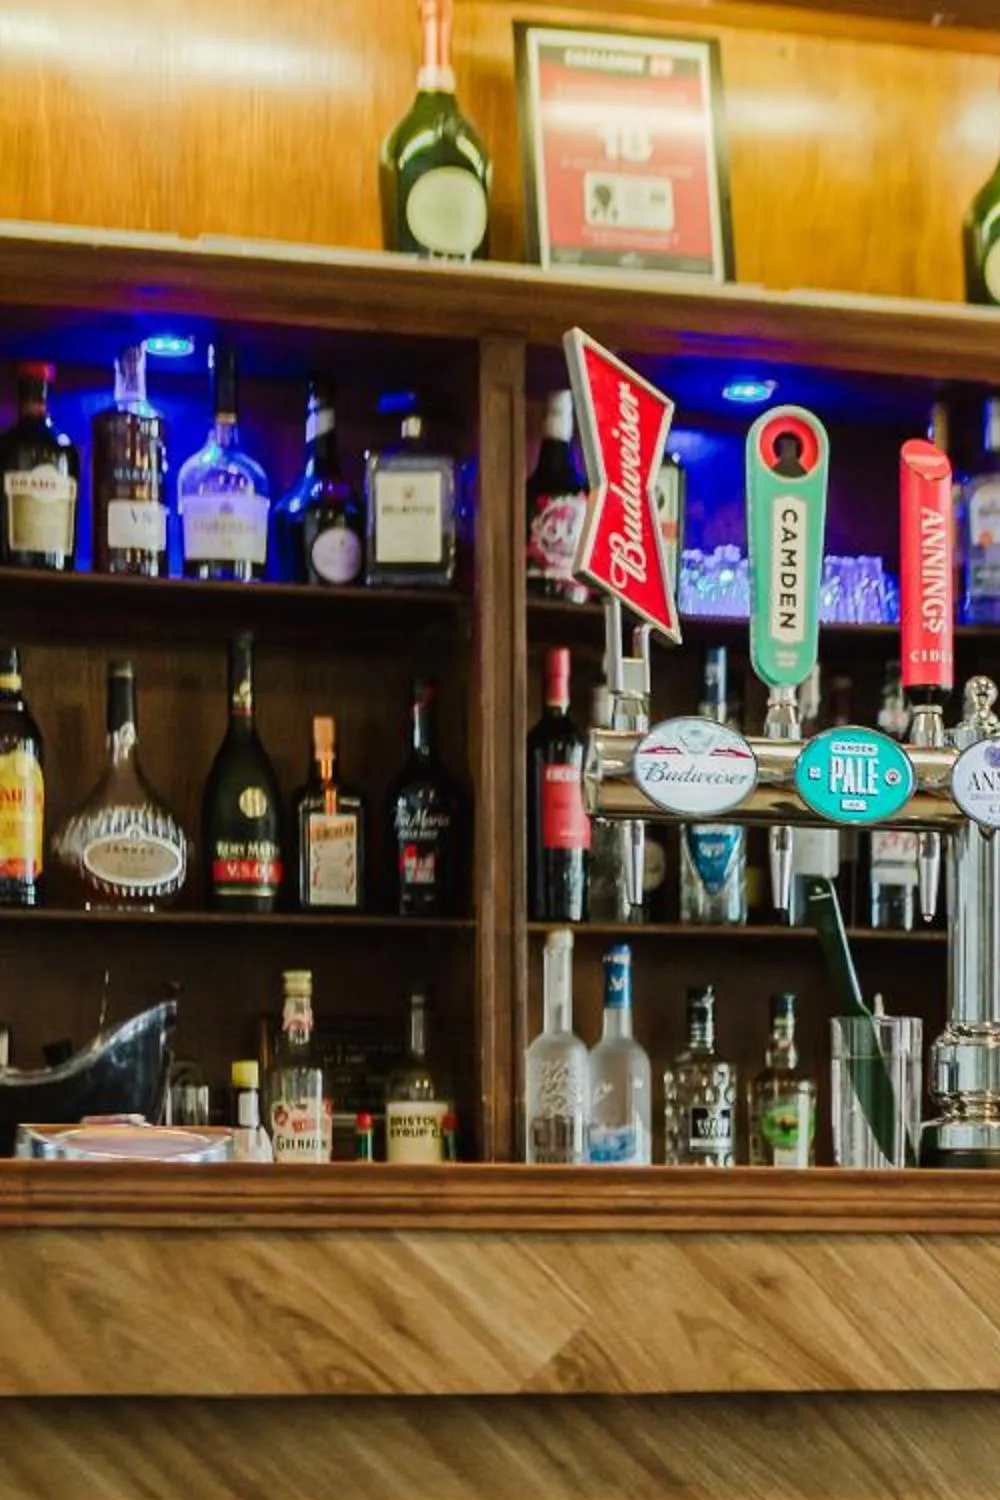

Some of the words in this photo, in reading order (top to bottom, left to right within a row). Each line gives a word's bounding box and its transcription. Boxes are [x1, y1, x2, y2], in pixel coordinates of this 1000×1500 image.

[608, 379, 648, 589] Budweiser
[779, 508, 799, 629] CAMDEN
[920, 506, 949, 635] ANNINGS
[642, 760, 749, 785] Budweiser
[829, 755, 879, 796] PALE
